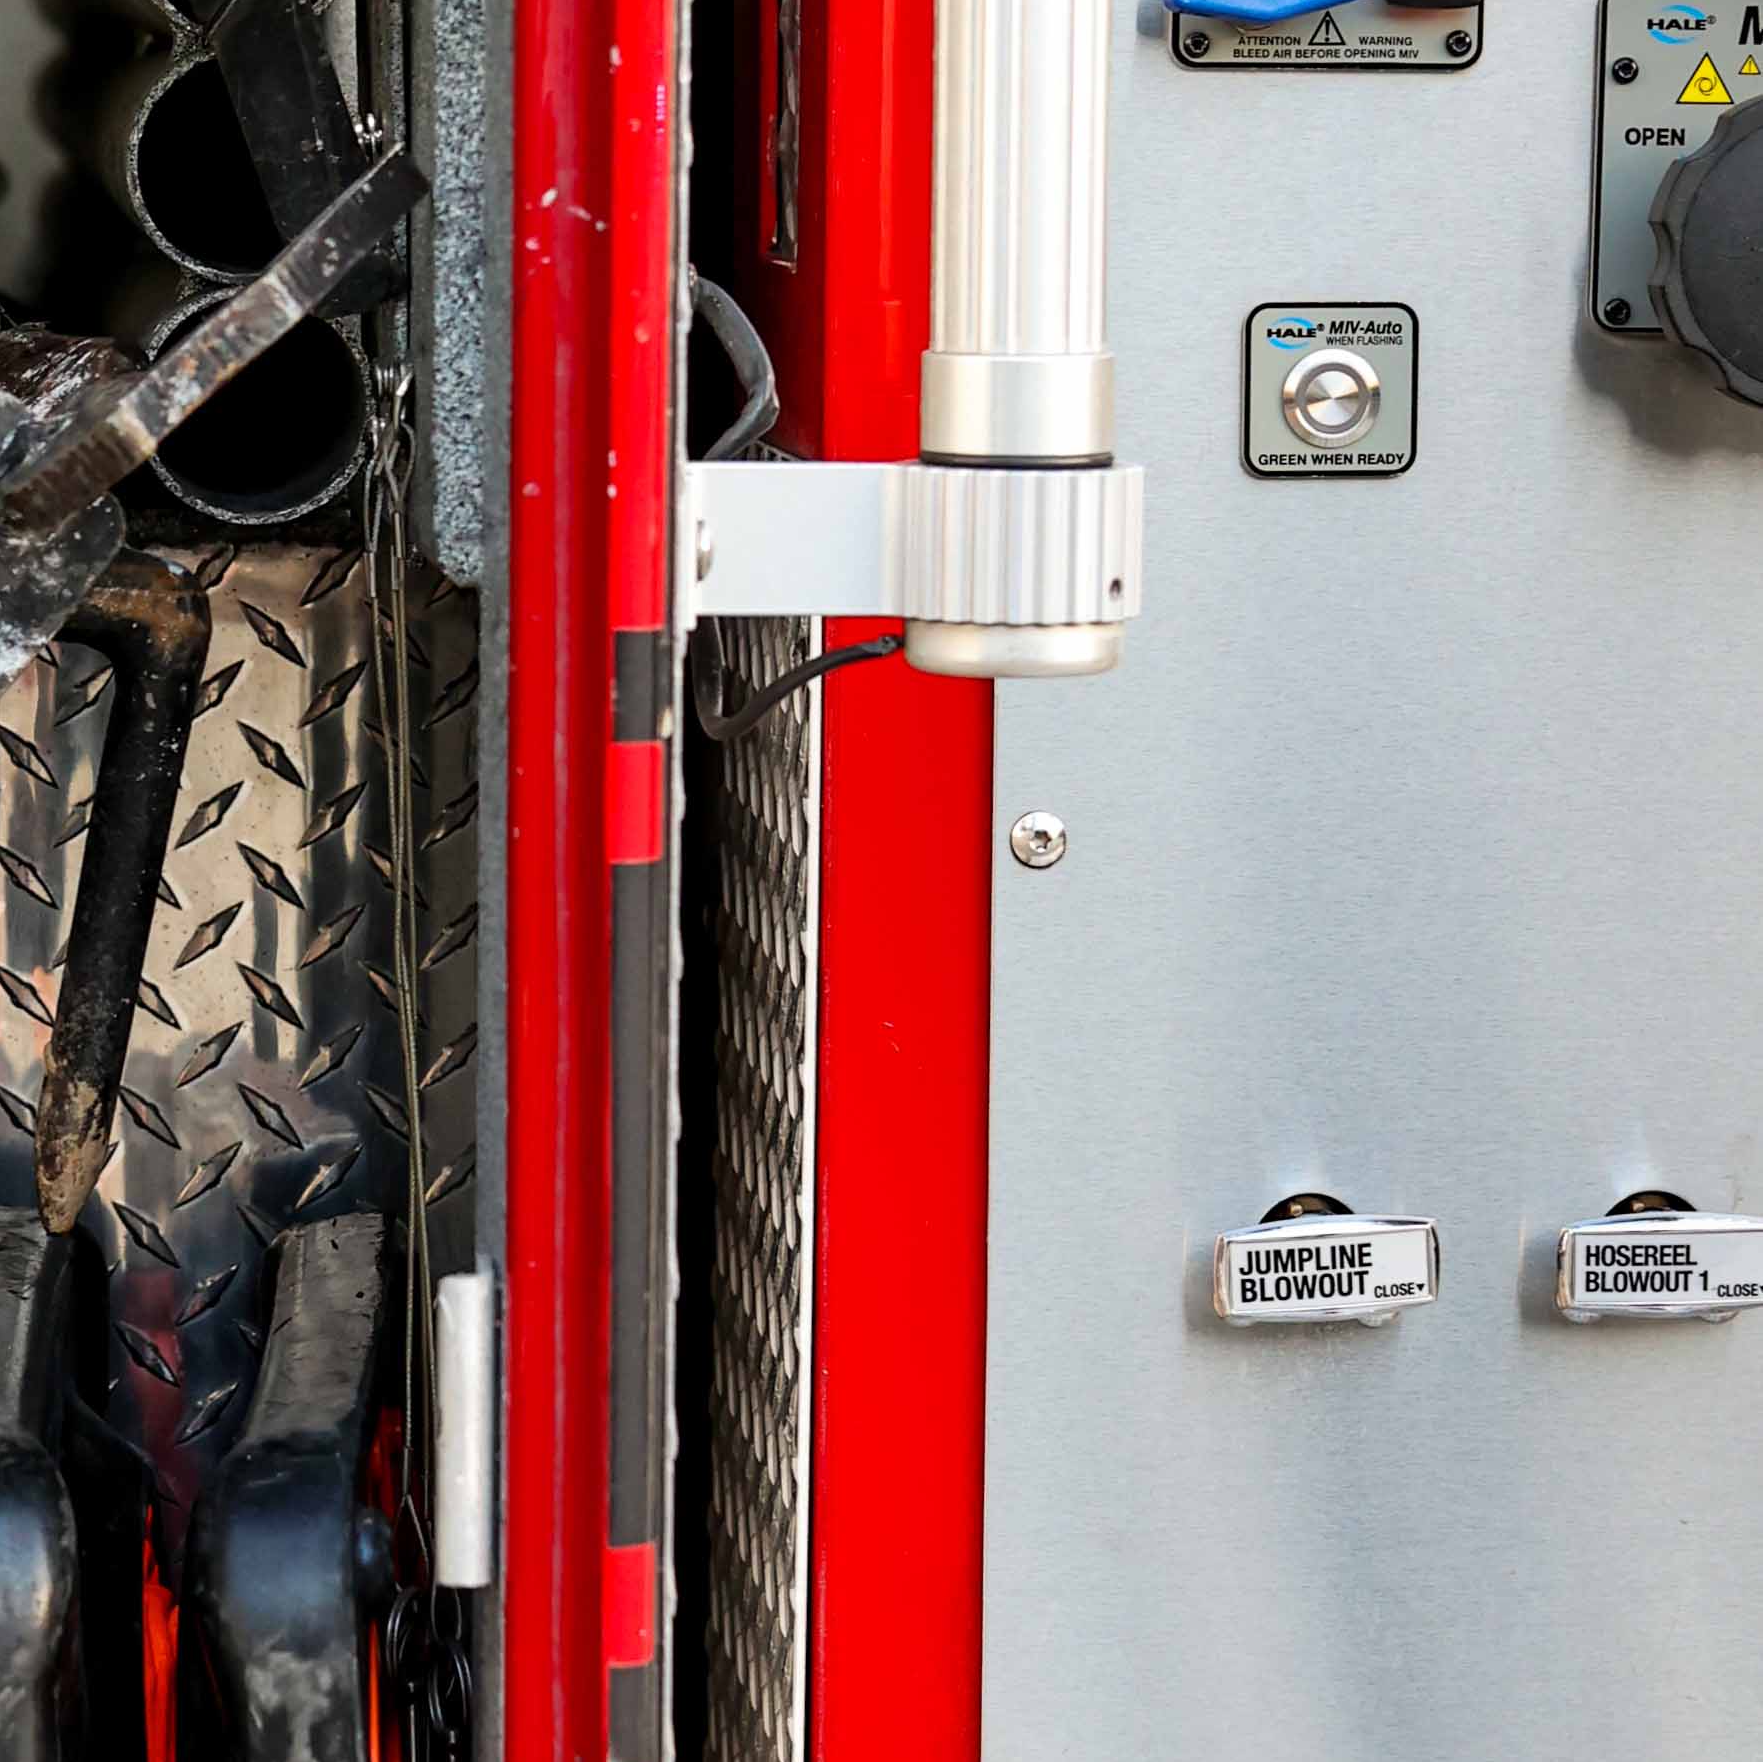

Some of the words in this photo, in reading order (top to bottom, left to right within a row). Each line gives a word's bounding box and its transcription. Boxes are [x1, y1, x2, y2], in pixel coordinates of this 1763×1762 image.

[1238, 36, 1301, 47] ATTENTION
[1359, 36, 1413, 47] WARNING
[1233, 48, 1270, 59] BLEED
[1273, 48, 1293, 59] AIR
[1295, 48, 1342, 59] BEFORE
[1344, 48, 1396, 59] OPENING
[1399, 49, 1419, 59] MIV
[1625, 128, 1686, 147] OPEN
[1329, 321, 1402, 335] MIV-Auto
[1326, 336, 1354, 346] WHEN
[1357, 336, 1403, 346] FLASHING
[1259, 454, 1307, 466] GREEN
[1311, 454, 1353, 465] WHEN
[1357, 453, 1405, 465] READY
[1240, 1243, 1373, 1276] JUMPLINE
[1585, 1245, 1698, 1267] HOSEREEL
[1241, 1270, 1369, 1303] BLOWOUT
[1374, 1282, 1415, 1298] CLOSE
[1585, 1270, 1692, 1293] BLOWOUT
[1699, 1270, 1709, 1292] 1
[1717, 1283, 1759, 1298] CLOSE
